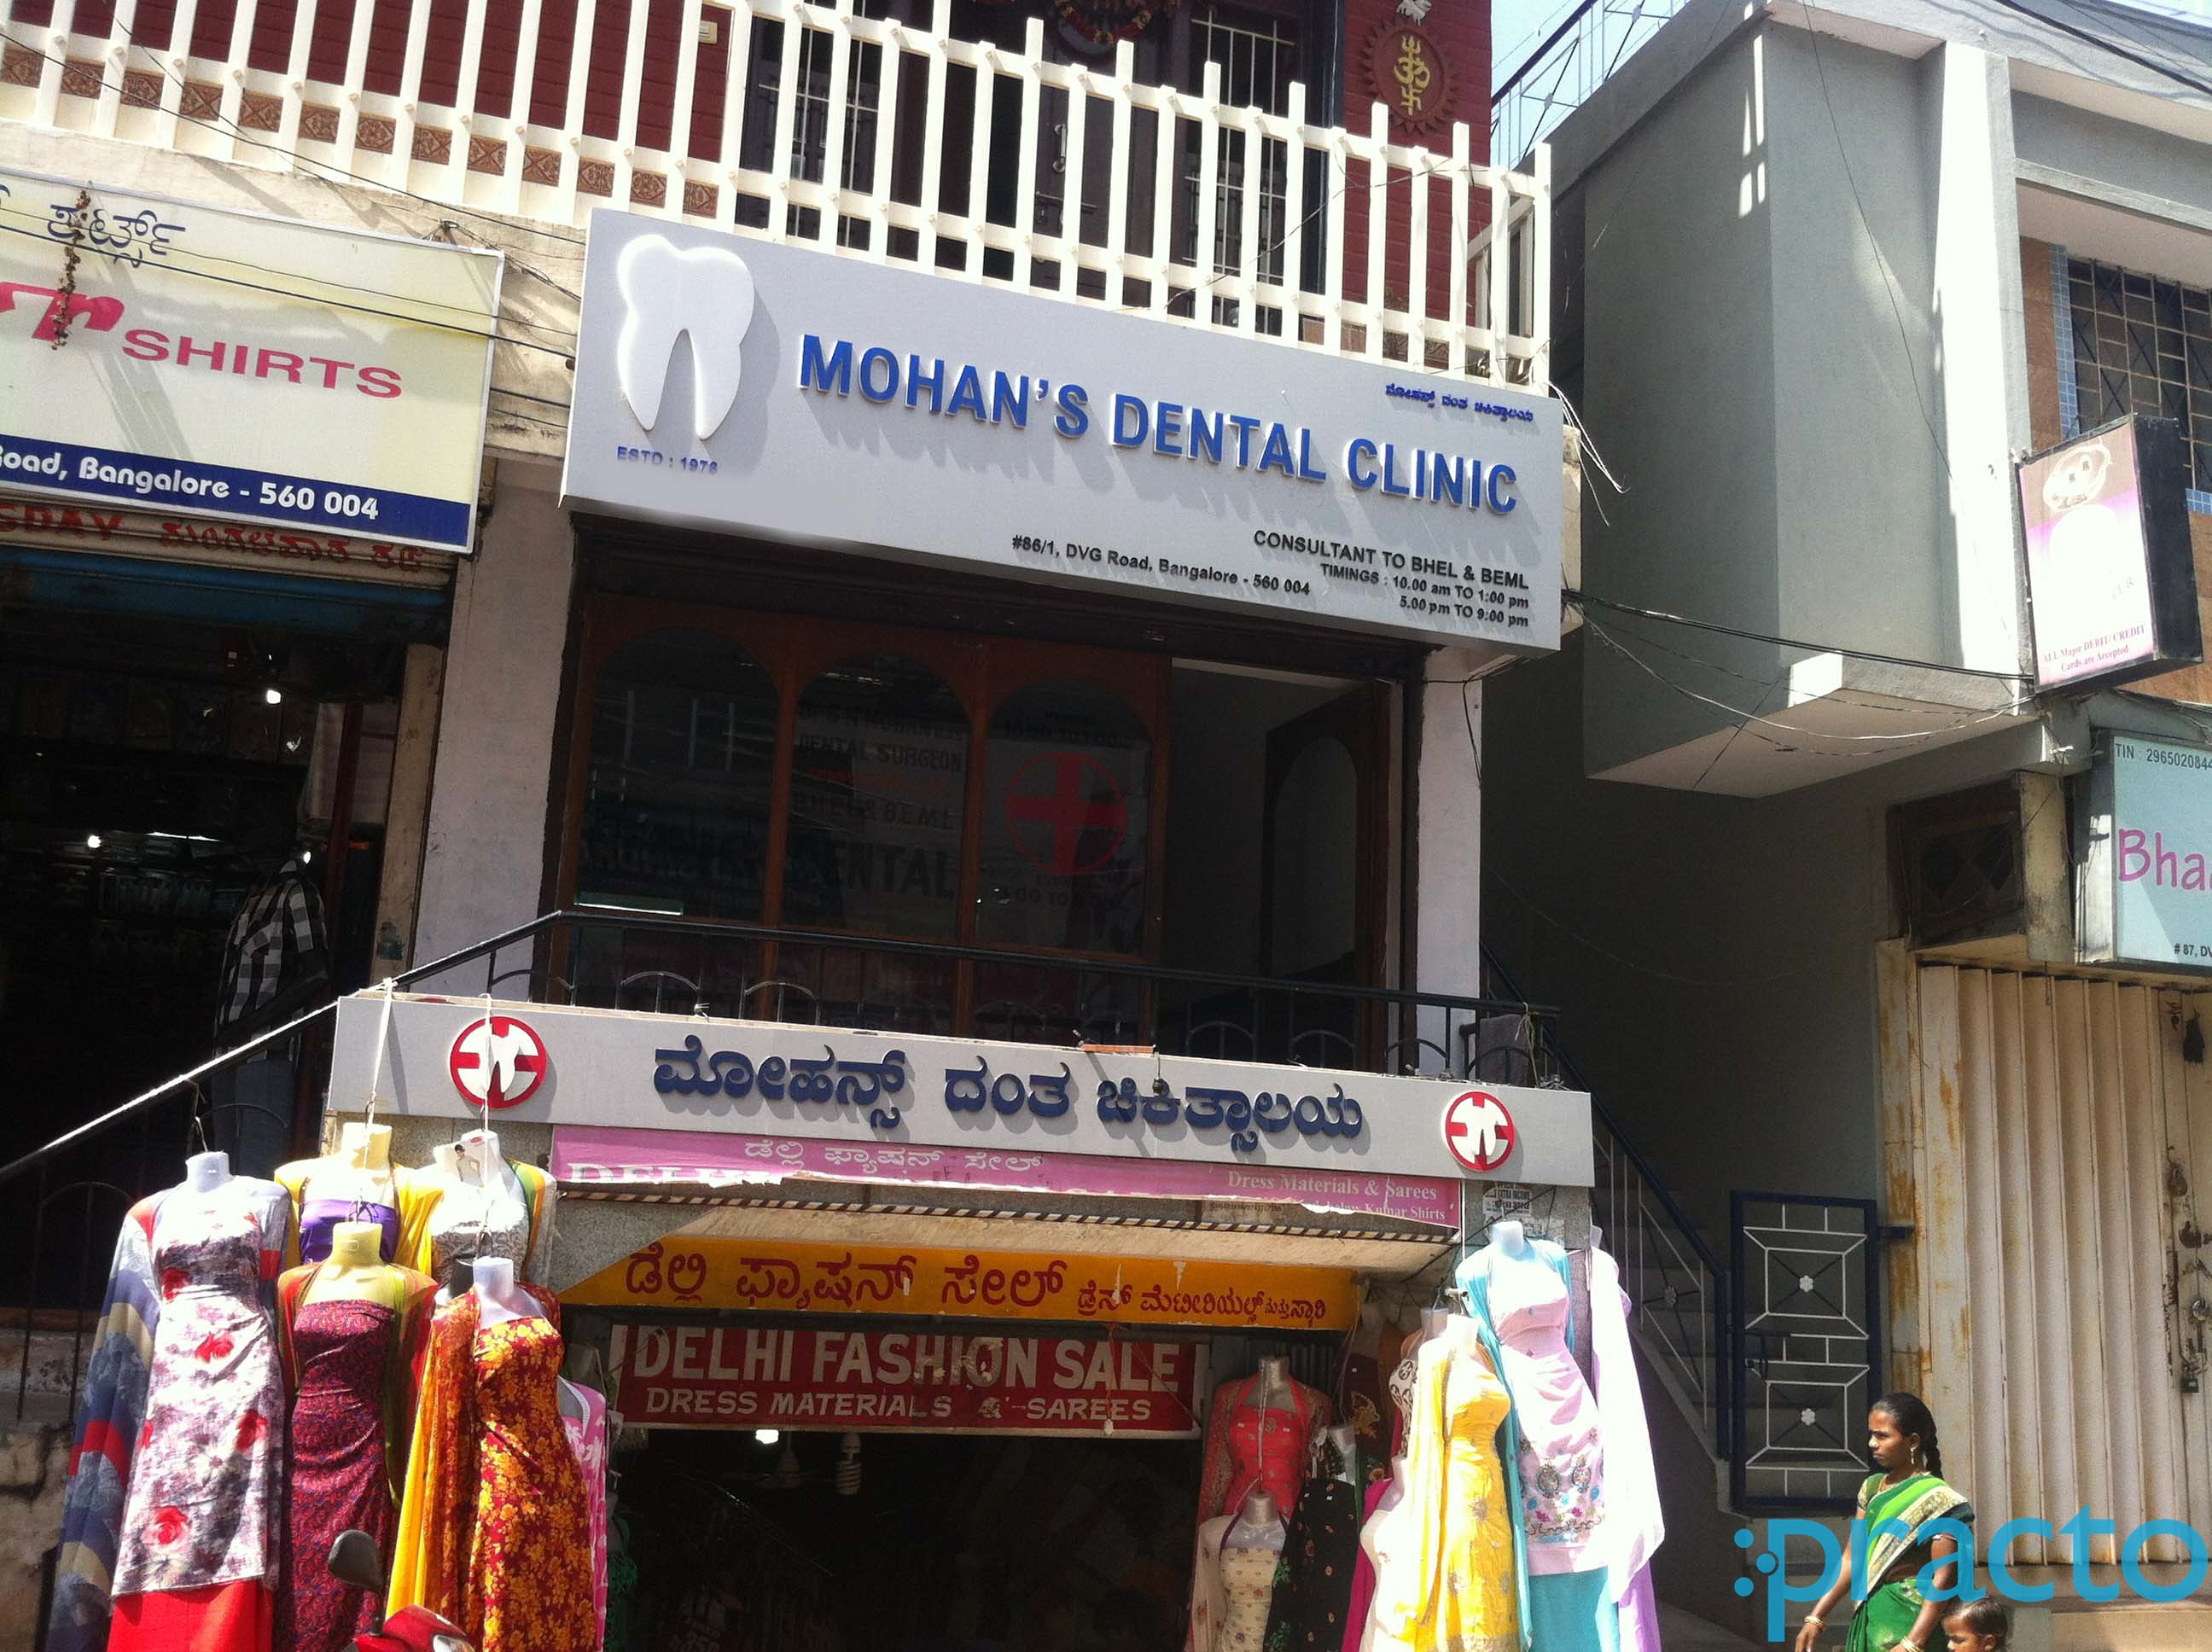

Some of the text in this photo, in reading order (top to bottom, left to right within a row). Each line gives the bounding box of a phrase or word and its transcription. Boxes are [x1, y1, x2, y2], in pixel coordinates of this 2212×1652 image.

[122, 329, 403, 398] SHIRTS
[798, 334, 1517, 515] MOHAN'S DENTAL CLINIC
[0, 446, 67, 480] oad,
[79, 456, 230, 495] Bangalore
[259, 482, 315, 510] 560
[324, 496, 379, 521] 004
[617, 445, 663, 465] ESTD
[681, 457, 718, 474] 1978
[1012, 534, 1060, 557] #86/1,
[1066, 543, 1102, 561] DVG
[1108, 550, 1153, 573] Road,
[1159, 558, 1238, 585] Bangalore
[1253, 574, 1279, 590] 560
[1284, 579, 1311, 596] 004
[1254, 530, 1529, 590] CONSULTANT TO BHEL & BEML
[1320, 563, 1379, 585] TIMINGS
[1394, 575, 1428, 592] 10.00
[1431, 584, 1451, 596] am
[1455, 585, 1473, 599] TO
[1478, 590, 1505, 605] 1:00
[1509, 596, 1529, 608] pm
[1400, 596, 1529, 628] 5.00 pm TO 9:00 pm
[2116, 742, 2134, 759] TIN
[2117, 828, 2212, 892] Bha
[654, 1033, 1364, 1152] ಮೋಹನ್ಸ್ ದಂತ ಚಿಕಿತ್ಸಾಲಯ
[1228, 1170, 1437, 1201] Dress Materials & Sarees
[1411, 1207, 1446, 1221] Shirts
[626, 1242, 707, 1303] ಡೆಲ್ಲಿ
[736, 1252, 917, 1310] ಫ್ಯಾಷನ್
[941, 1254, 1068, 1306] ಸೇಲ್
[634, 1324, 1179, 1393] DELHI FASHION SALE
[646, 1387, 758, 1415] DRESS
[770, 1392, 952, 1418] MATERIALS
[1027, 1398, 1151, 1421] SAREES
